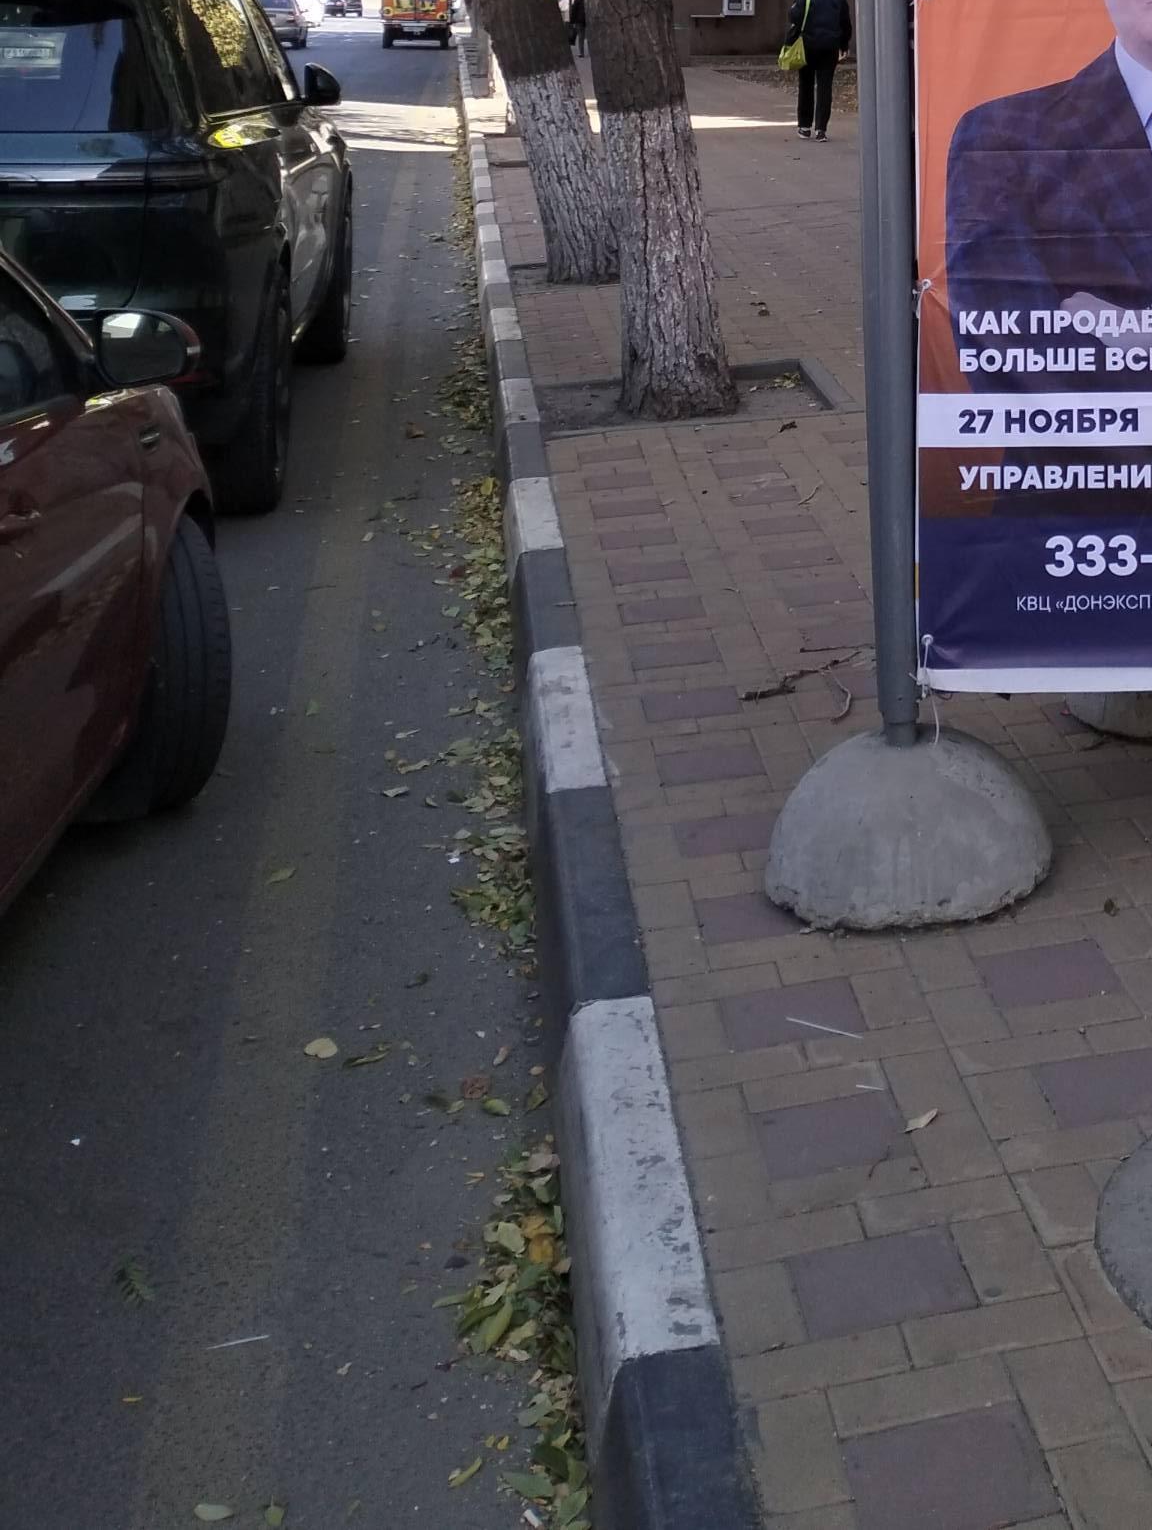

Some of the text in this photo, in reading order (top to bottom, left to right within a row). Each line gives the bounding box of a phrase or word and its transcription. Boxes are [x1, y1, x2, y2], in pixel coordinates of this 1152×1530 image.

[959, 310, 1021, 336] КАК
[959, 347, 1096, 373] БОЛЬШЕ
[958, 408, 1139, 434] 27 НОЯБРЯ
[1016, 595, 1052, 613] КВЦ
